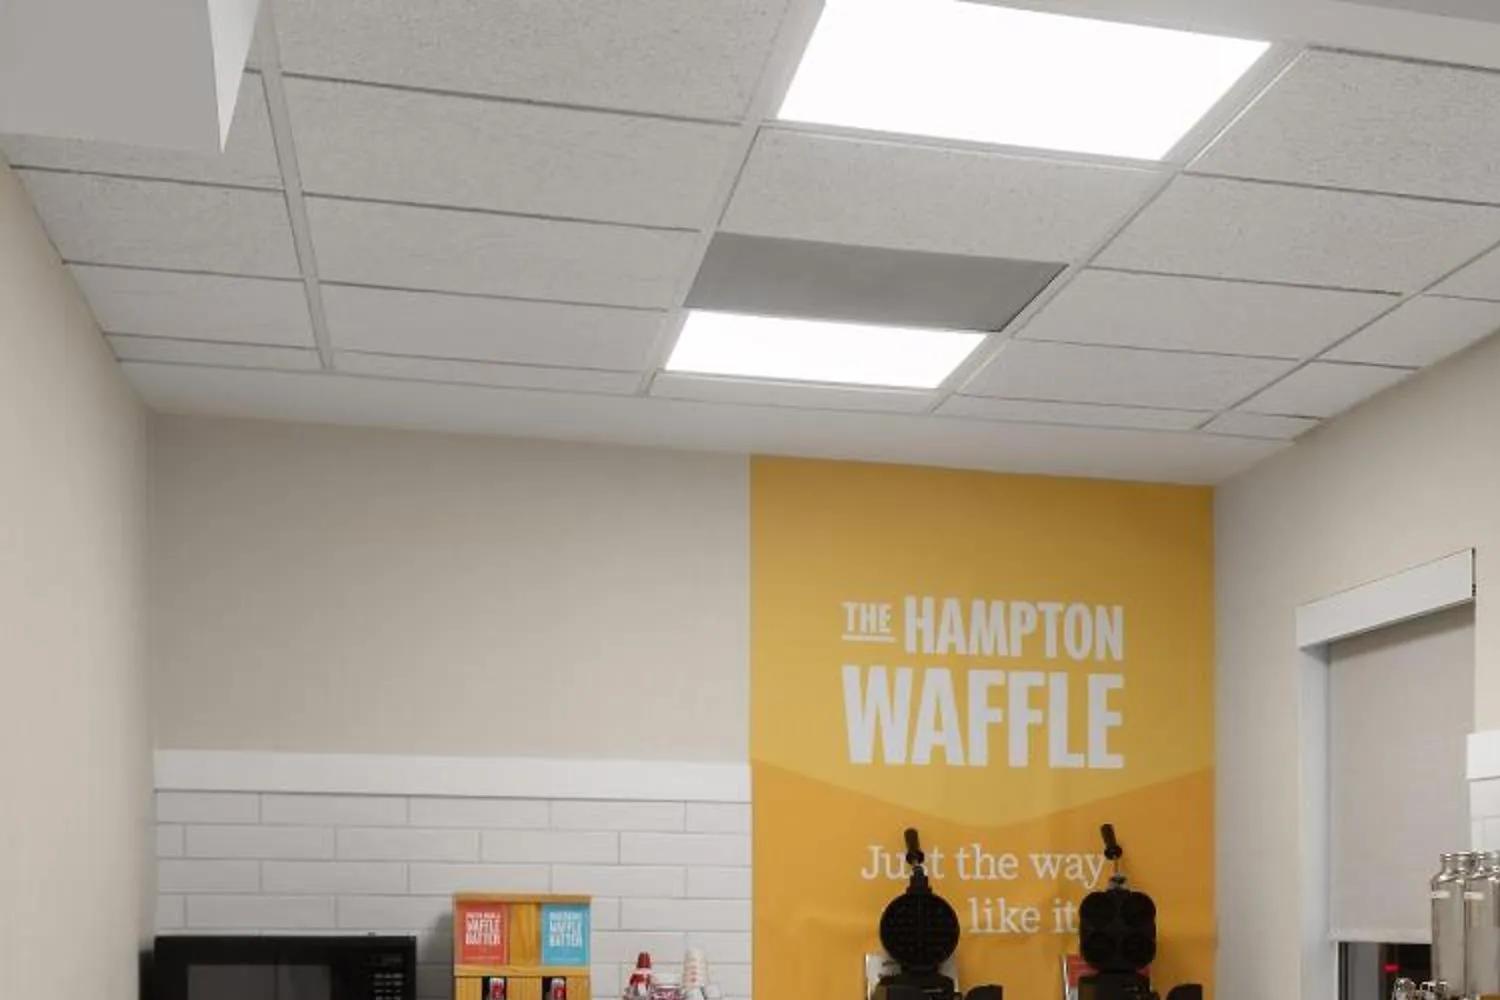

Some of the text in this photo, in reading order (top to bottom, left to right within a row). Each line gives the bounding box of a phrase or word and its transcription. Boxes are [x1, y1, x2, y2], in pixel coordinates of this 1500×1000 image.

[841, 596, 1124, 661] THE HAMPTON
[842, 664, 1124, 769] WAFFLE
[861, 843, 1105, 889] Jut the way
[465, 919, 501, 932] WAFFLE
[968, 898, 1079, 934] like it
